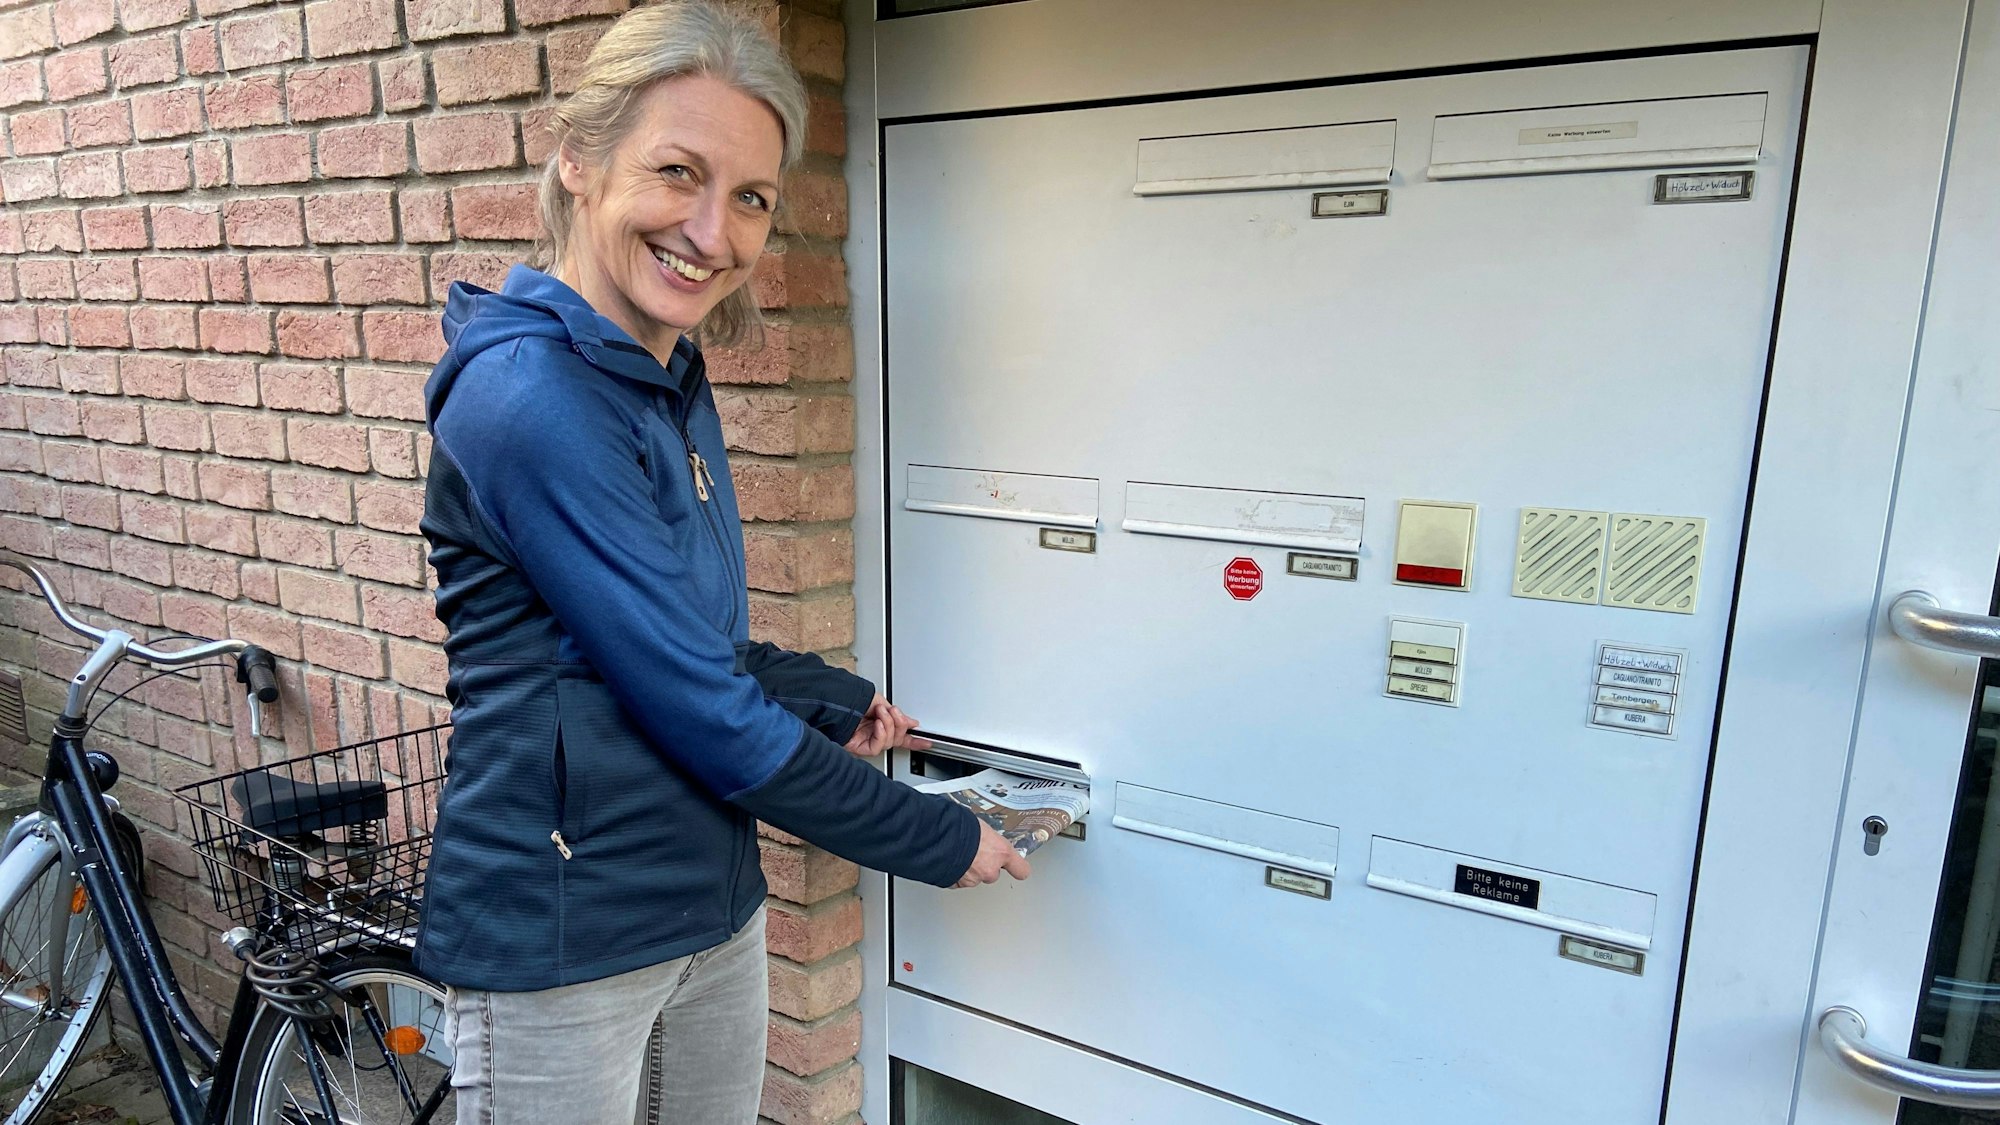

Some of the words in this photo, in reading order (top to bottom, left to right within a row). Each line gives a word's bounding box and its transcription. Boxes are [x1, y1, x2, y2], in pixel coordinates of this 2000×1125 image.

[1228, 575, 1259, 585] Werbung
[1414, 665, 1433, 675] MÜLLER
[1409, 682, 1429, 693] SPIEGEL
[1624, 713, 1646, 723] KUBERA
[1466, 869, 1492, 884] Bitte
[1498, 876, 1529, 892] keine
[1472, 882, 1520, 903] Reklame
[1593, 949, 1614, 961] KUBERA
